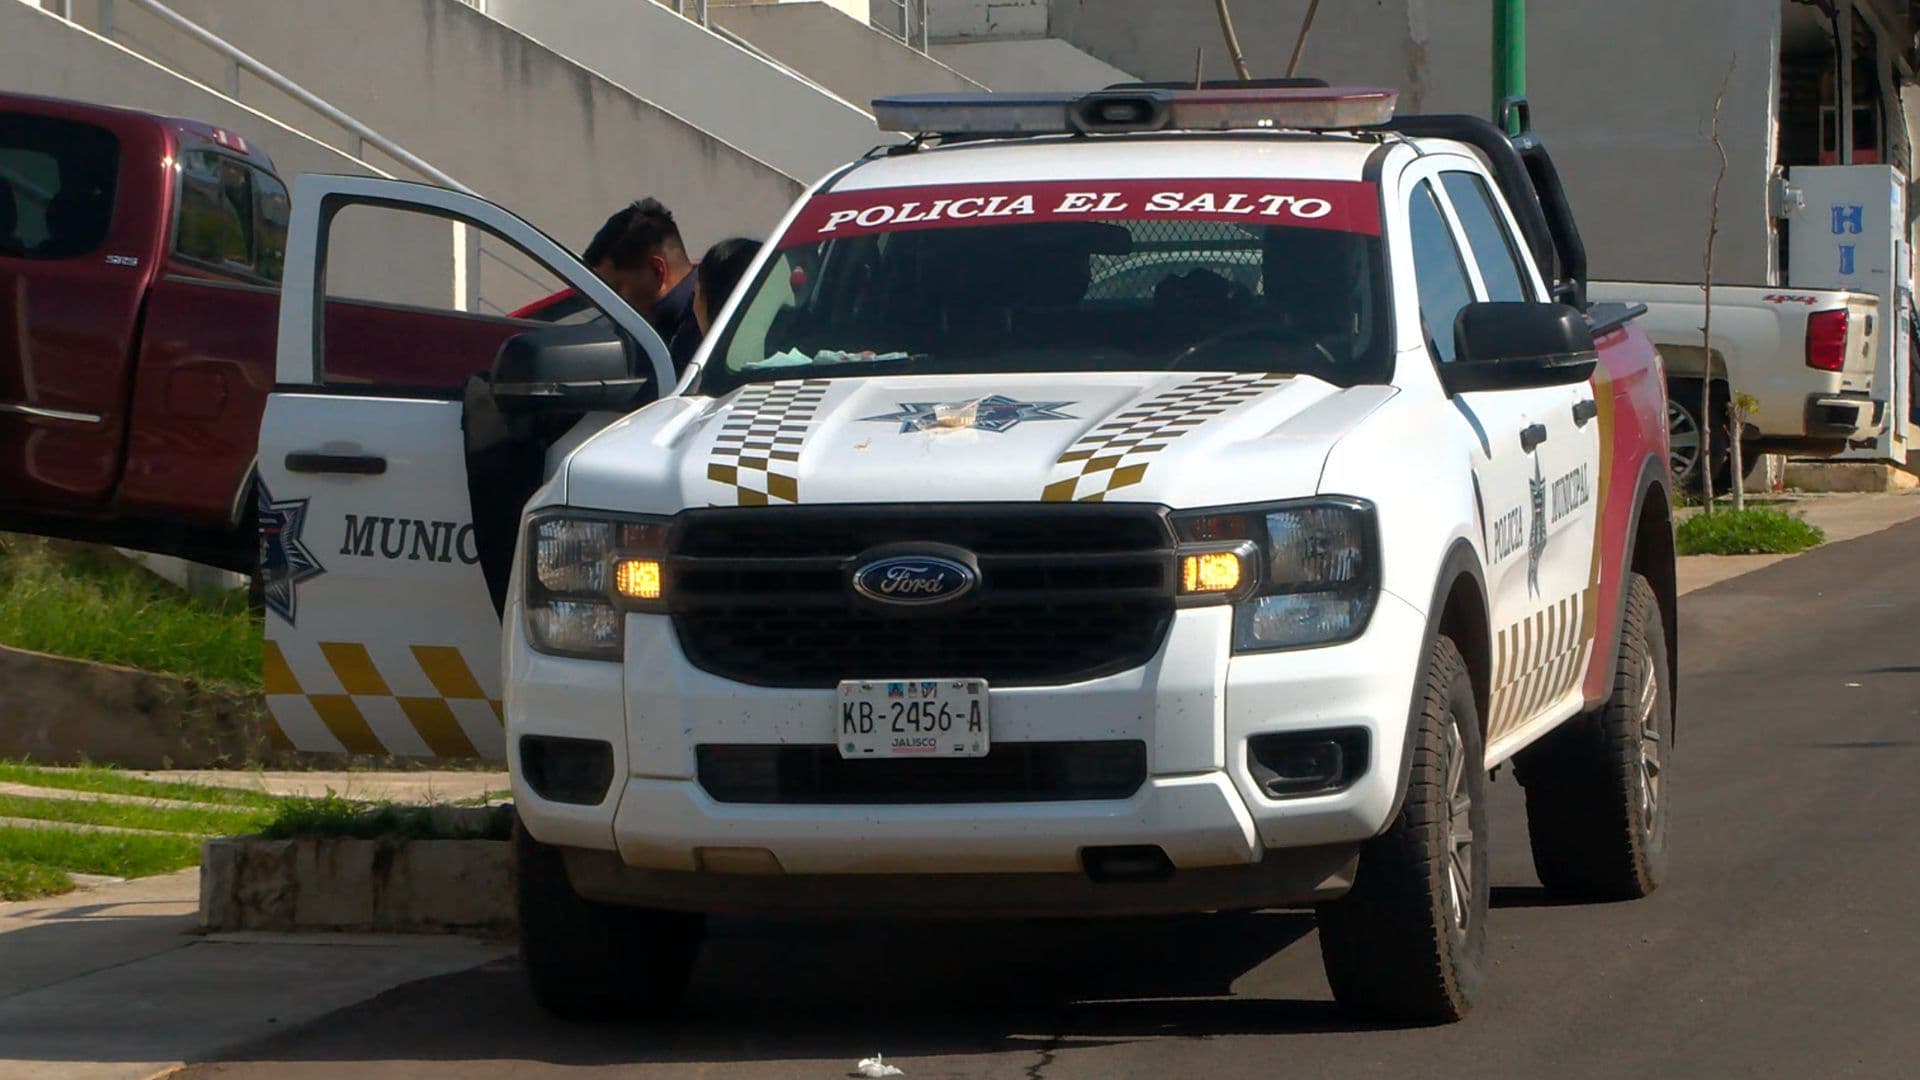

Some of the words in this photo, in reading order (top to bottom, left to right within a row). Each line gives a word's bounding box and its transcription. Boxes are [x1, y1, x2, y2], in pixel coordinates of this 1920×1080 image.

[818, 194, 1035, 233] POLICIA
[1053, 191, 1132, 212] EL
[1145, 191, 1332, 219] SALTO
[880, 565, 945, 594] Ford
[843, 699, 982, 734] KB-2456-A
[891, 737, 937, 748] JALISCO
